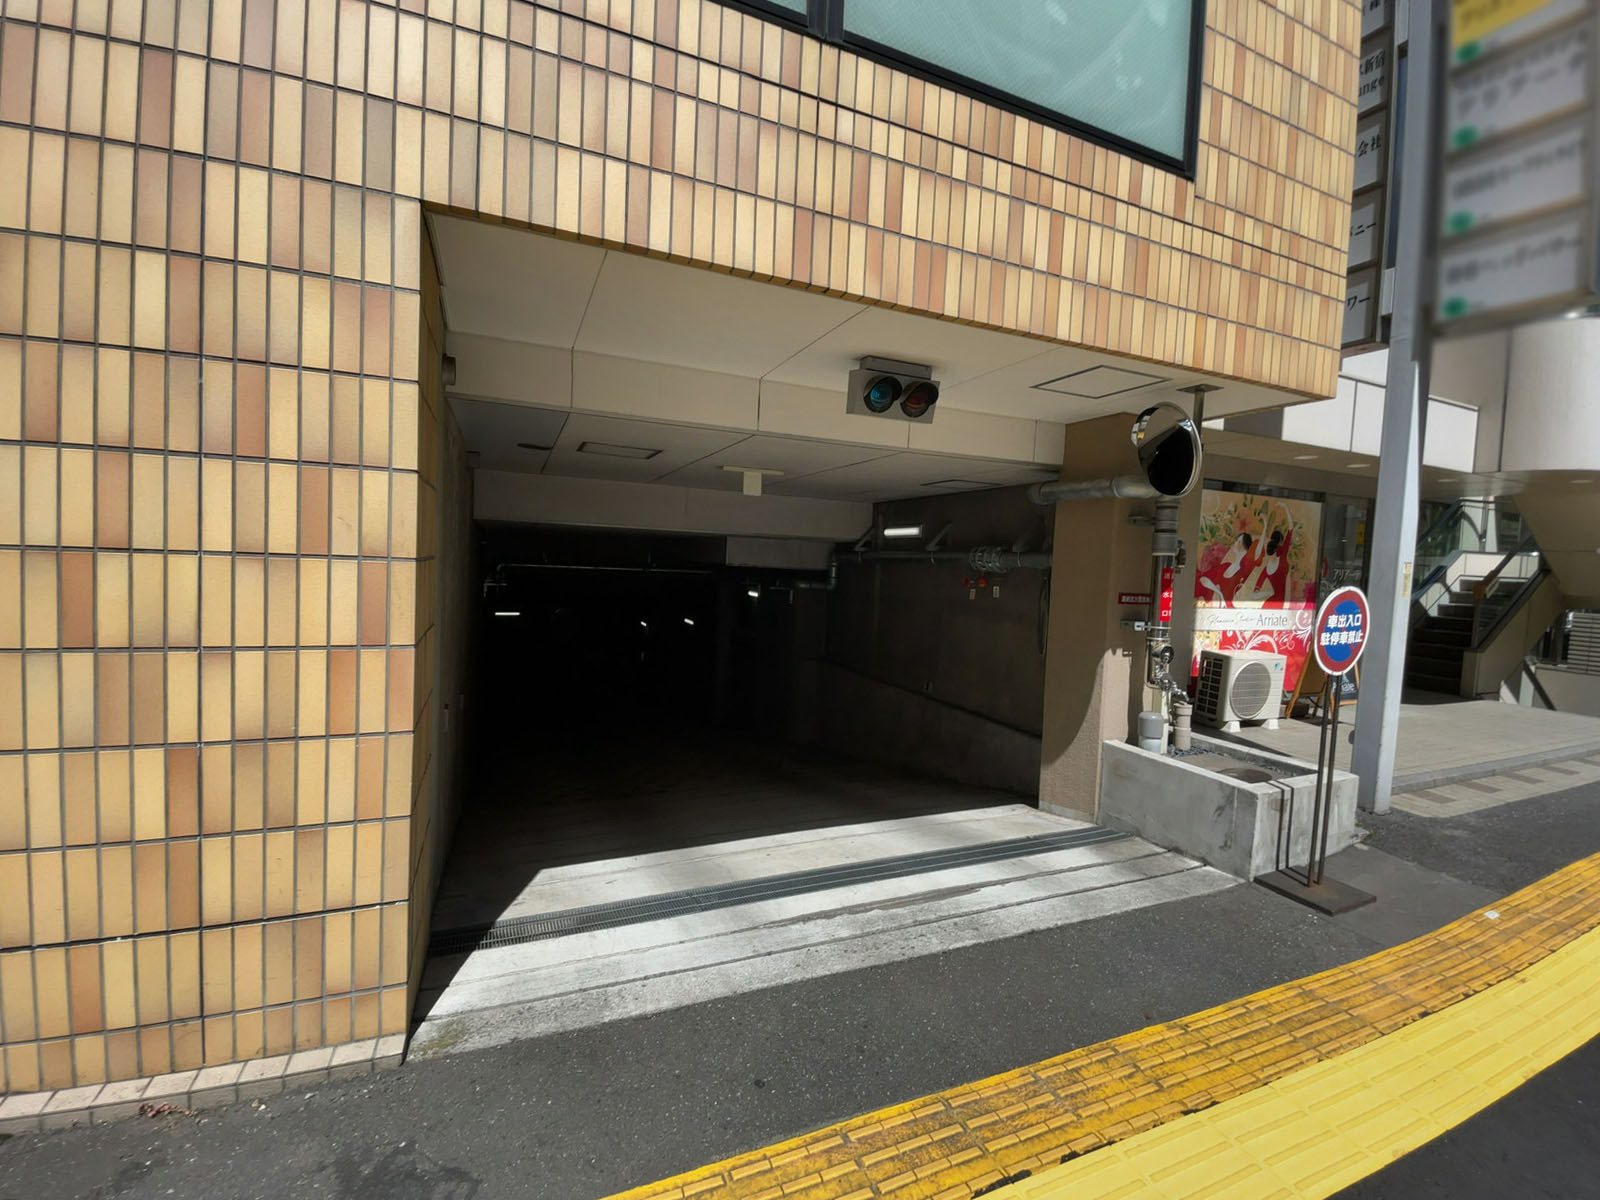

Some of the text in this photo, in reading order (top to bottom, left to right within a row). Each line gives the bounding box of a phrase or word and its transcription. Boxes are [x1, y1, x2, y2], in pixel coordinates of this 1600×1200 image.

[1358, 134, 1381, 157] 会社
[1256, 613, 1288, 627] Arriate
[1327, 613, 1362, 628] 車出入口
[1320, 630, 1363, 646] 駐停車禁止
